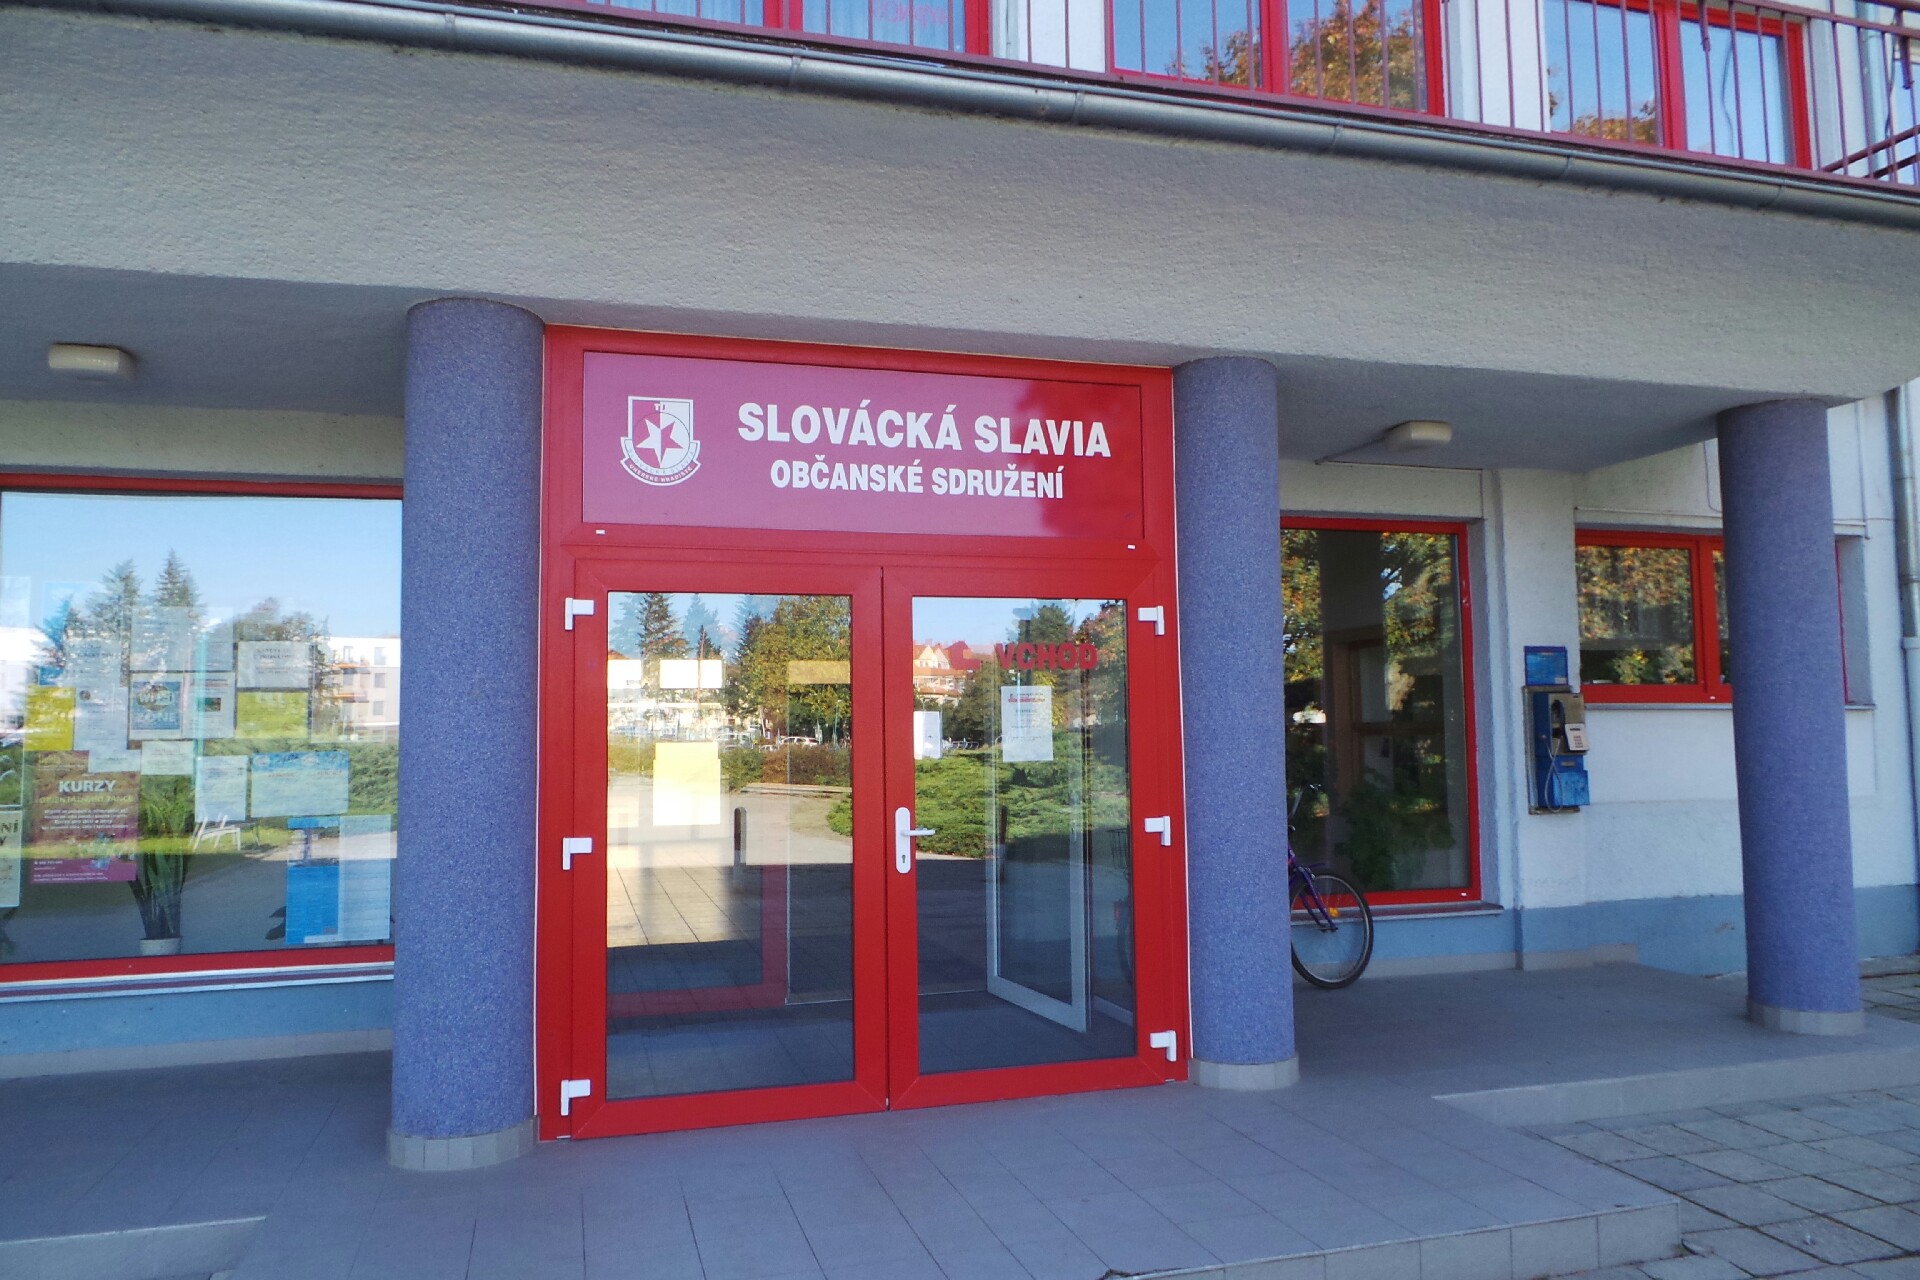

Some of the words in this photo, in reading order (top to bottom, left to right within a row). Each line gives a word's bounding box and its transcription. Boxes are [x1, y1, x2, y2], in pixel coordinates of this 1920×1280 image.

[737, 399, 963, 451] SLOVÁCKÁ
[974, 415, 1112, 458] SLAVIA
[770, 454, 924, 494] OBČANSKÉ
[931, 463, 1065, 499] SDRUŽENÍ
[994, 641, 1099, 671] VCHOD
[58, 779, 117, 793] KURZY
